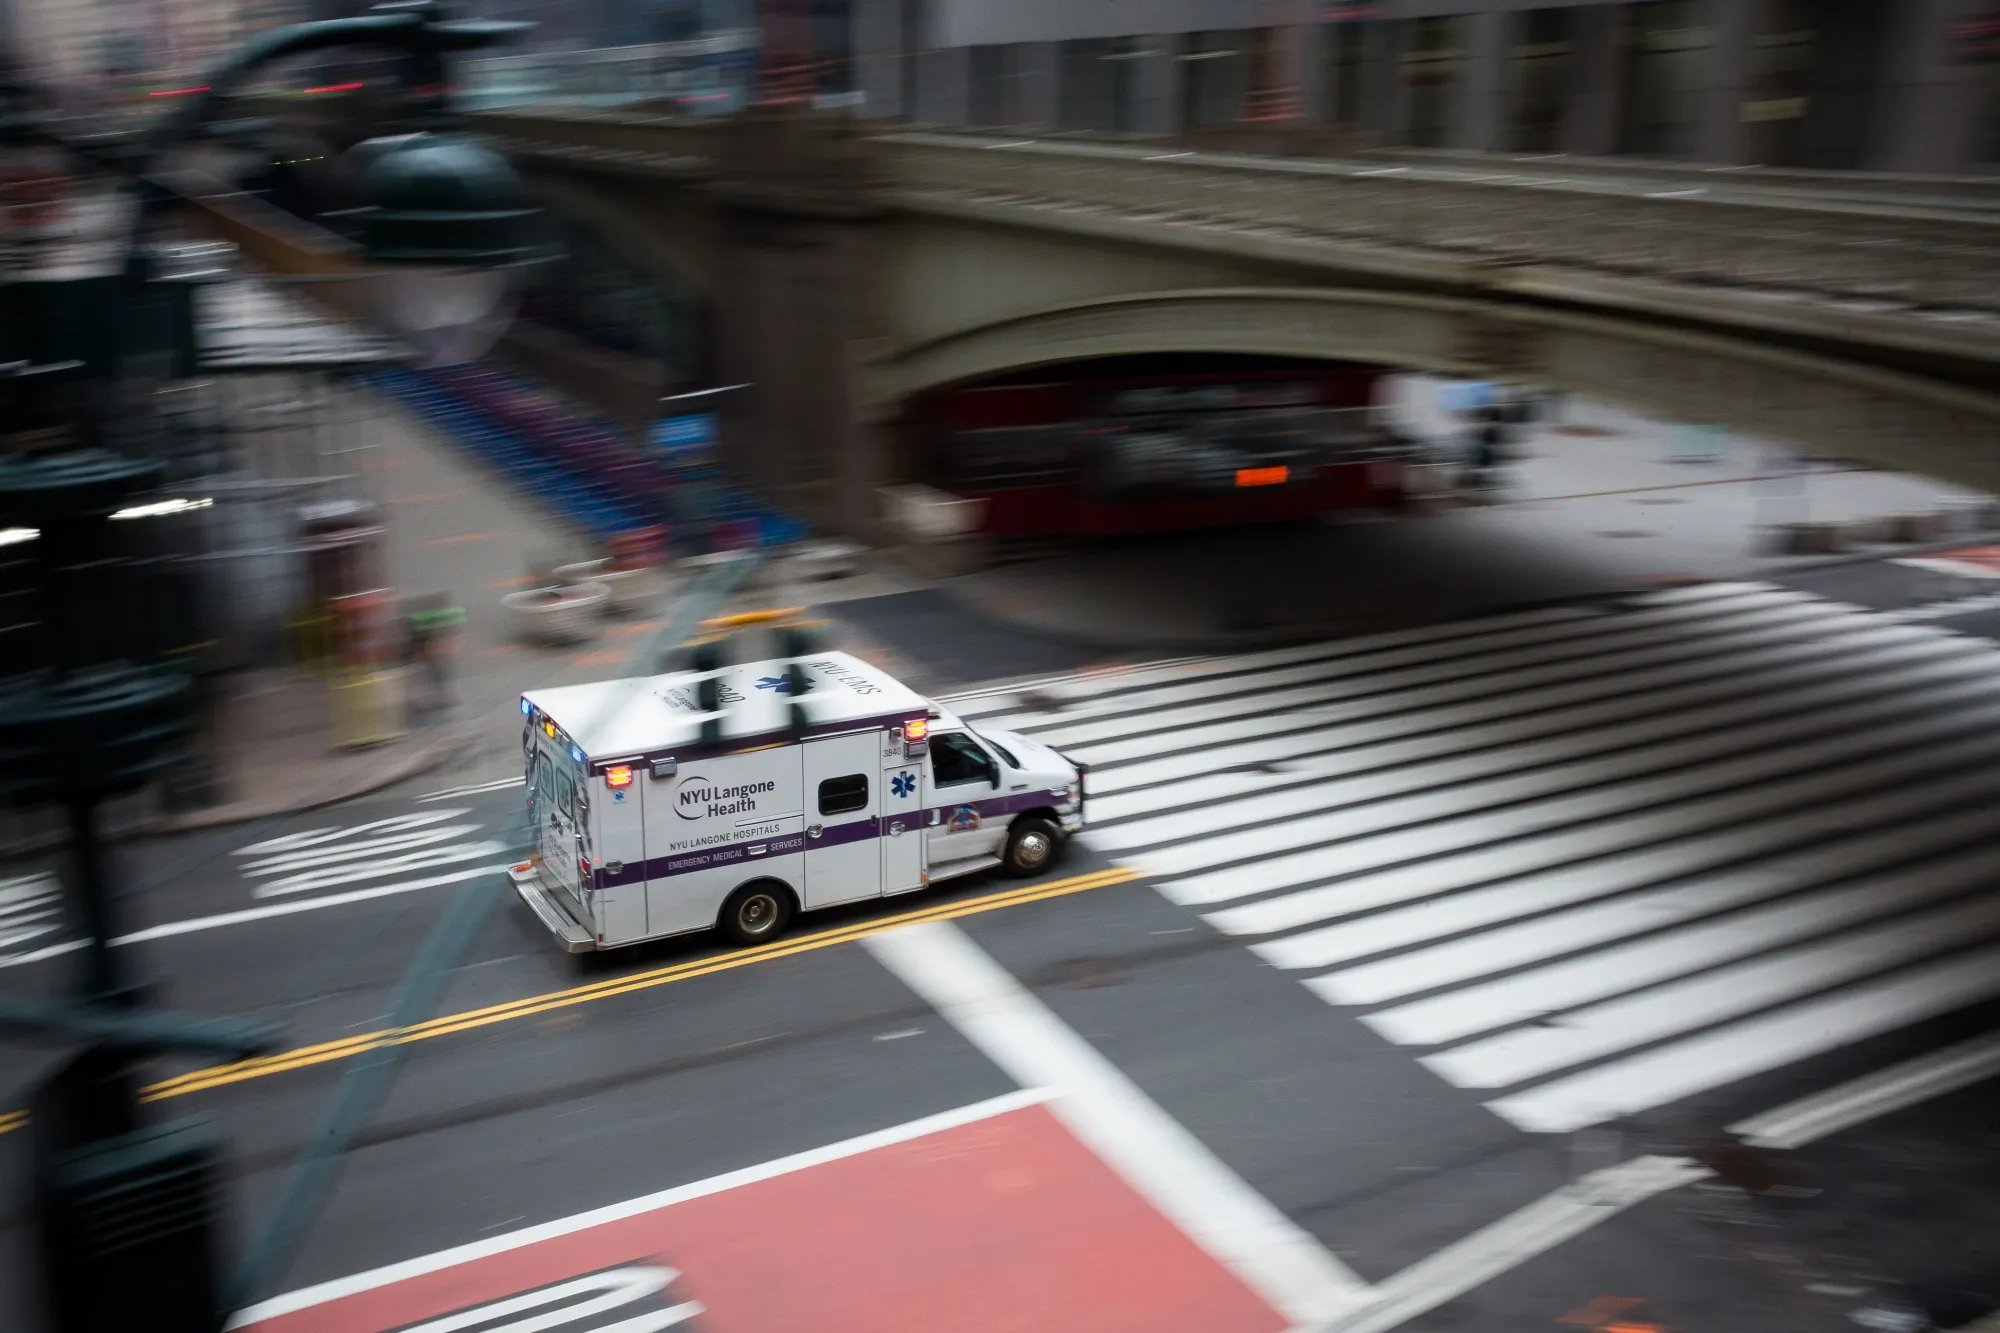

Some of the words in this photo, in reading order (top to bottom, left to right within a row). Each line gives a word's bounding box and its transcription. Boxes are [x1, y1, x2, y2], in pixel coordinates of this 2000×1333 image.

[883, 747, 901, 758] 3840
[680, 787, 711, 806] NYU
[714, 780, 775, 800] Langone
[708, 797, 756, 817] Health
[670, 841, 688, 851] NYU
[690, 833, 731, 848] LANGONE
[733, 824, 780, 840] HOSPITALS
[668, 854, 711, 870] EMERGENCY
[713, 849, 743, 862] MEDICAL
[770, 838, 803, 851] SERVICES
